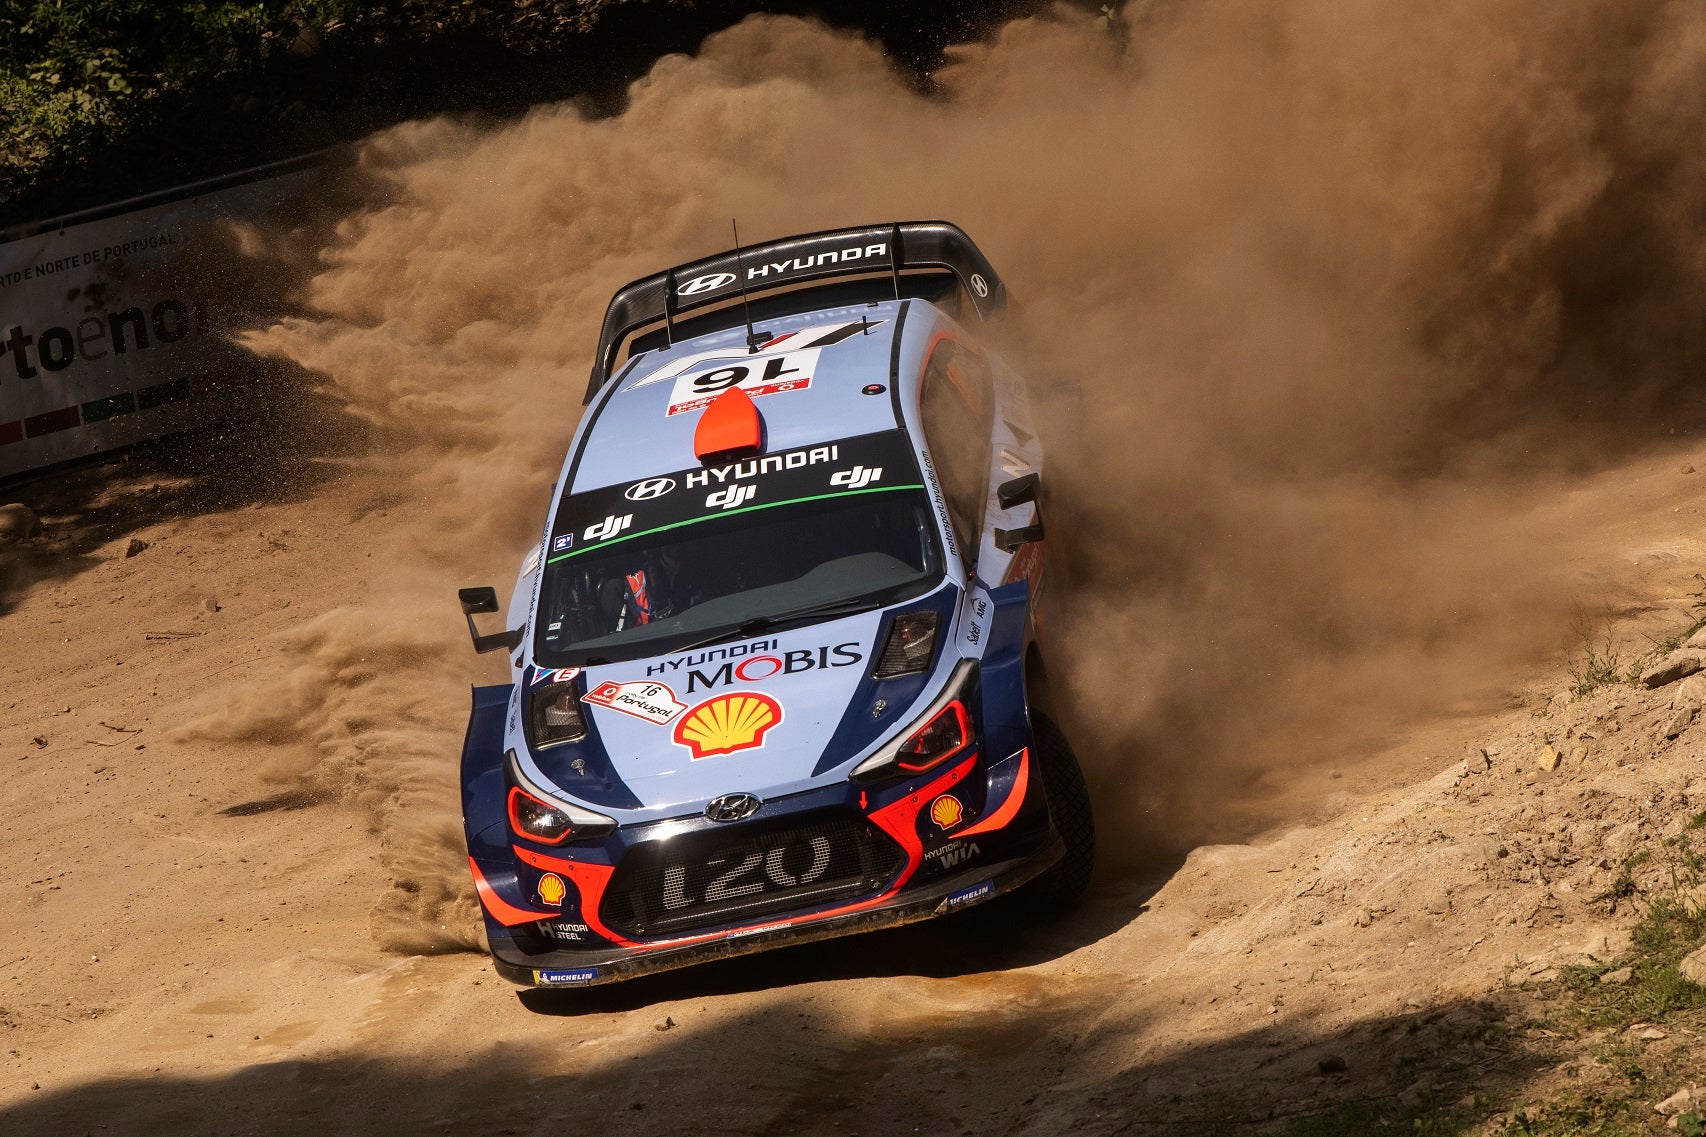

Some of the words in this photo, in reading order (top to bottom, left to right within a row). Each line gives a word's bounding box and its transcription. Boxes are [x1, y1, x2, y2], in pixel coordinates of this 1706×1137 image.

[24, 268, 33, 281] E
[35, 255, 80, 277] NORTE
[83, 249, 101, 265] DE
[103, 233, 177, 260] PORTUGAL
[748, 242, 887, 280] HYUNDA
[692, 357, 800, 394] 16
[686, 445, 838, 489] HYUNDAI
[921, 450, 958, 557] motorsport.hyundai.com
[646, 639, 778, 677] HYUNDAI
[685, 641, 863, 695] MOBIS
[616, 694, 673, 718] Portugal
[640, 684, 661, 697] 16
[924, 840, 962, 861] HYUNDAI
[553, 923, 589, 933] HYUNDAI
[557, 931, 582, 941] STEEL
[550, 973, 593, 982] MICHELIN
